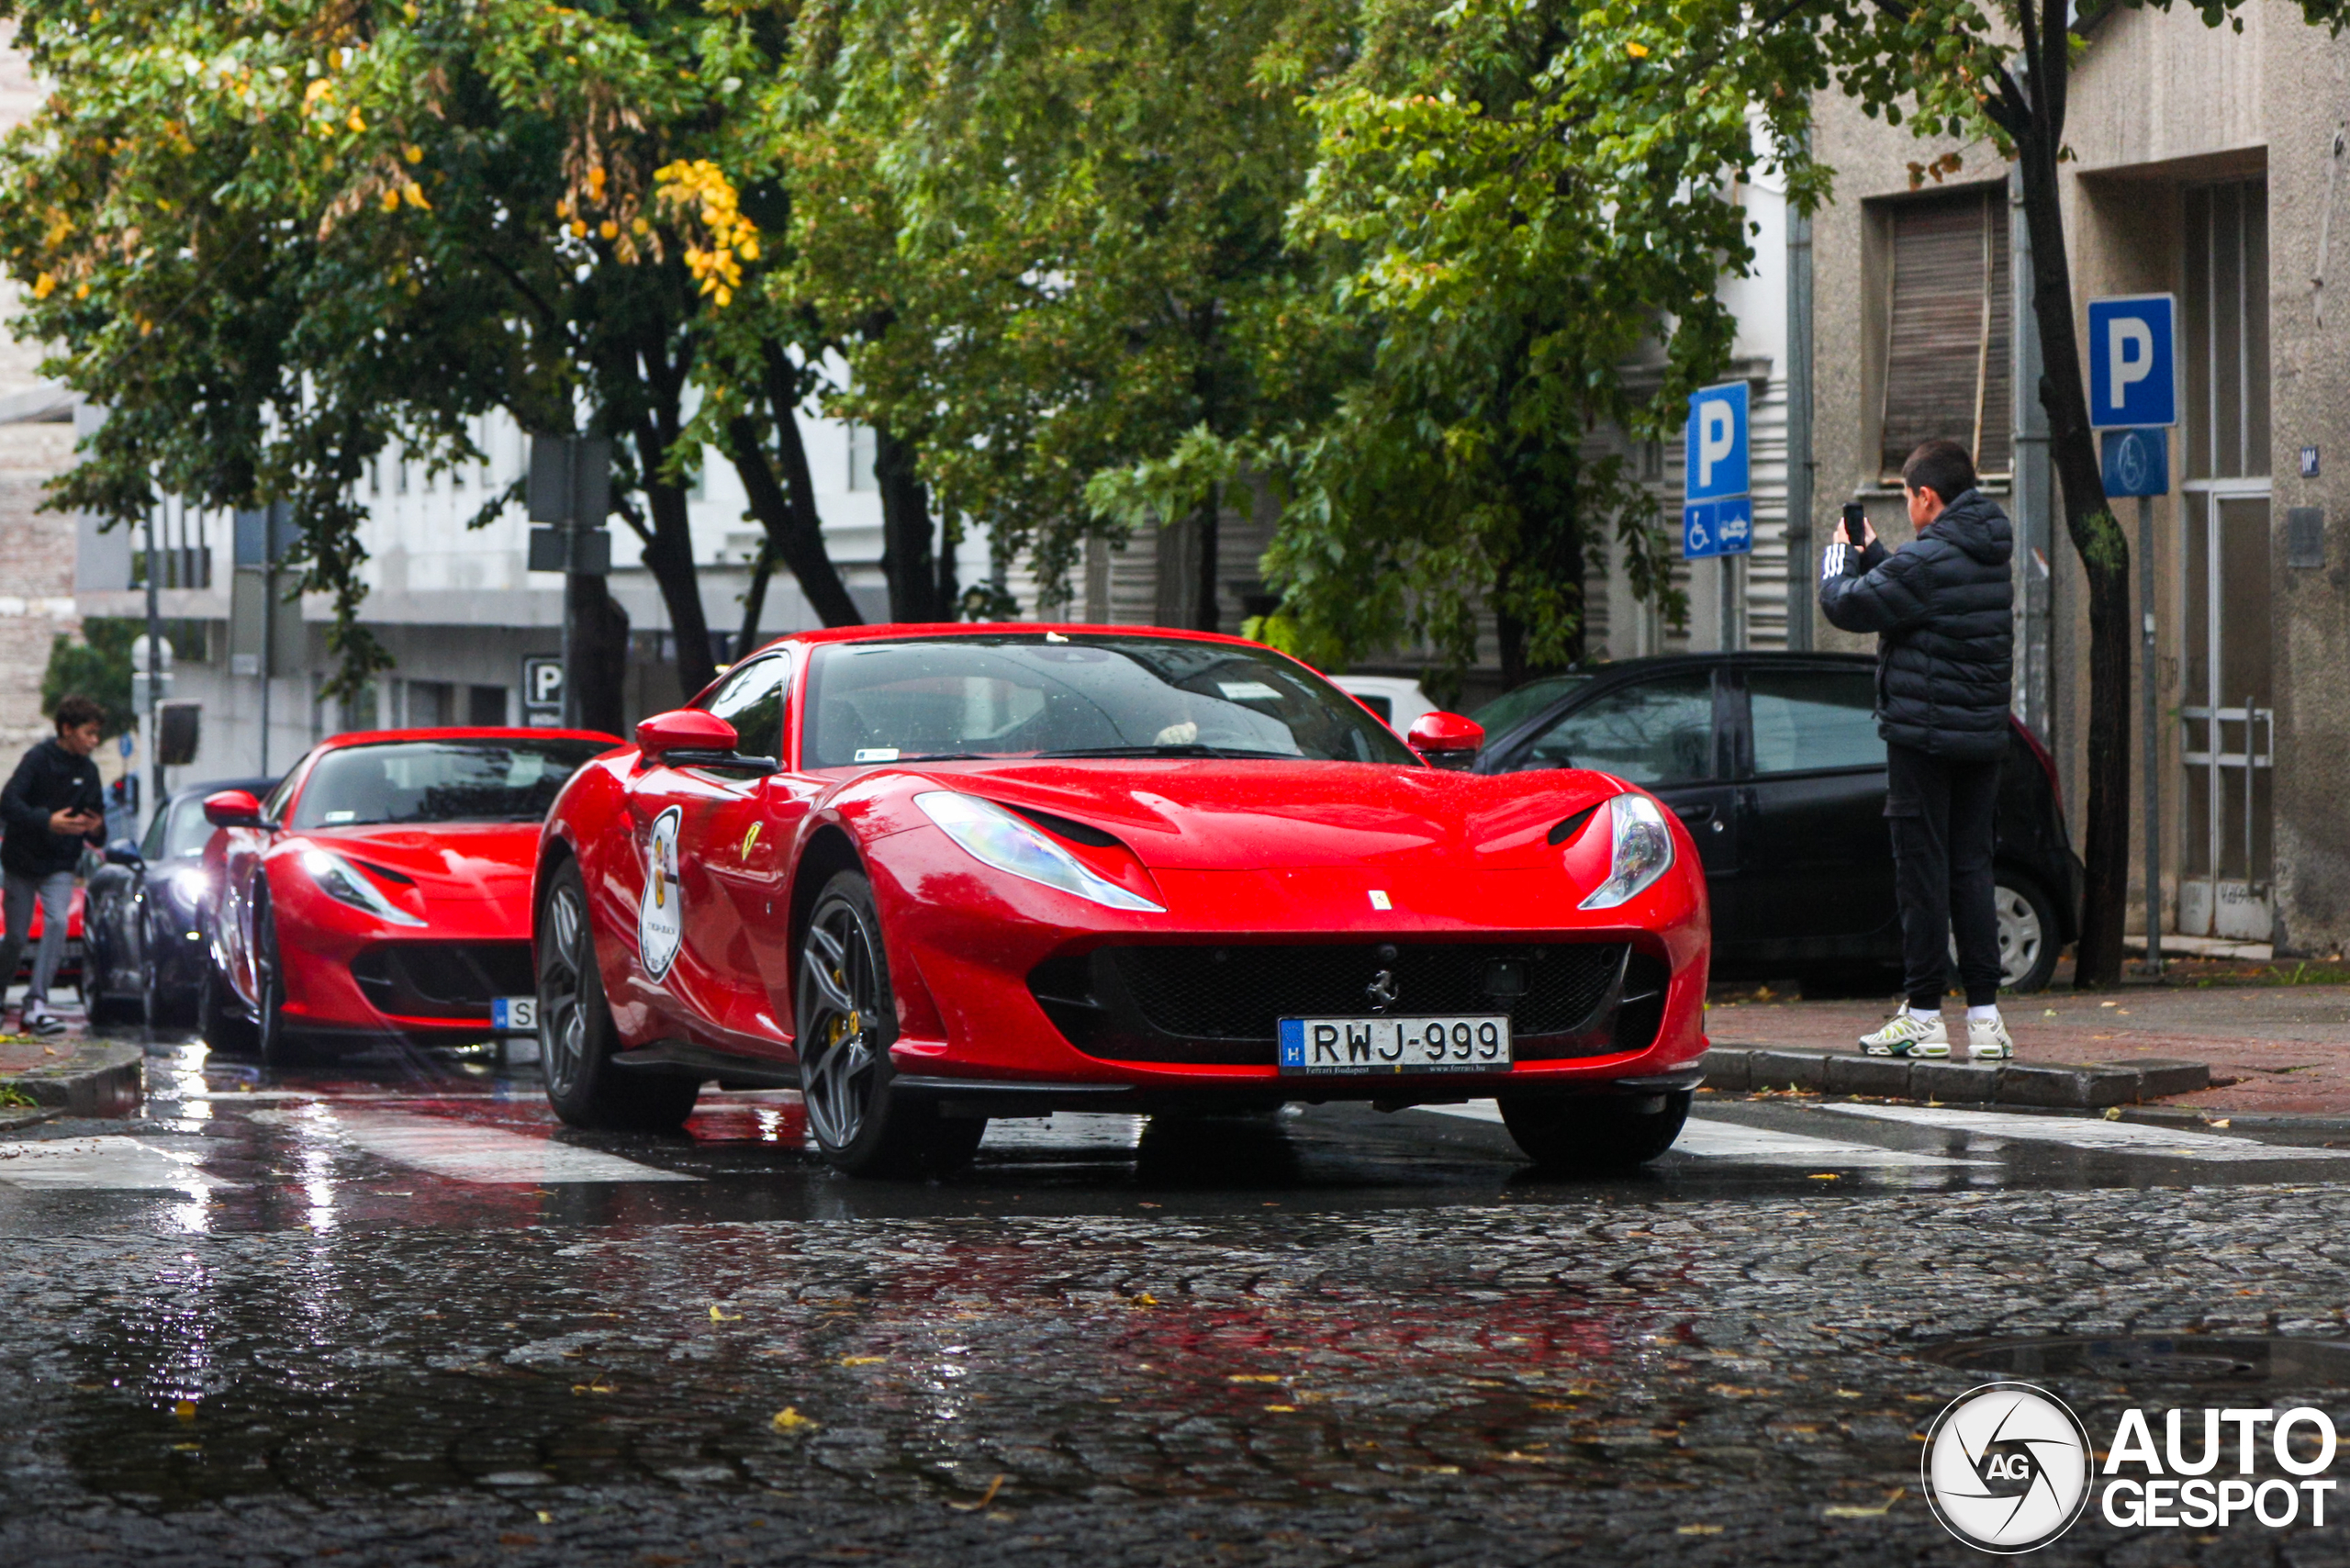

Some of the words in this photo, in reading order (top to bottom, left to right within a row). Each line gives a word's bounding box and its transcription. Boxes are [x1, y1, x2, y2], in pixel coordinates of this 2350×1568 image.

[2109, 317, 2154, 409] P
[1700, 398, 1735, 487] P
[537, 666, 562, 700] P
[516, 1002, 531, 1025] S
[1287, 1047, 1300, 1061] H
[1313, 1022, 1499, 1063] RWJ-999
[1334, 1066, 1370, 1075] Budapest
